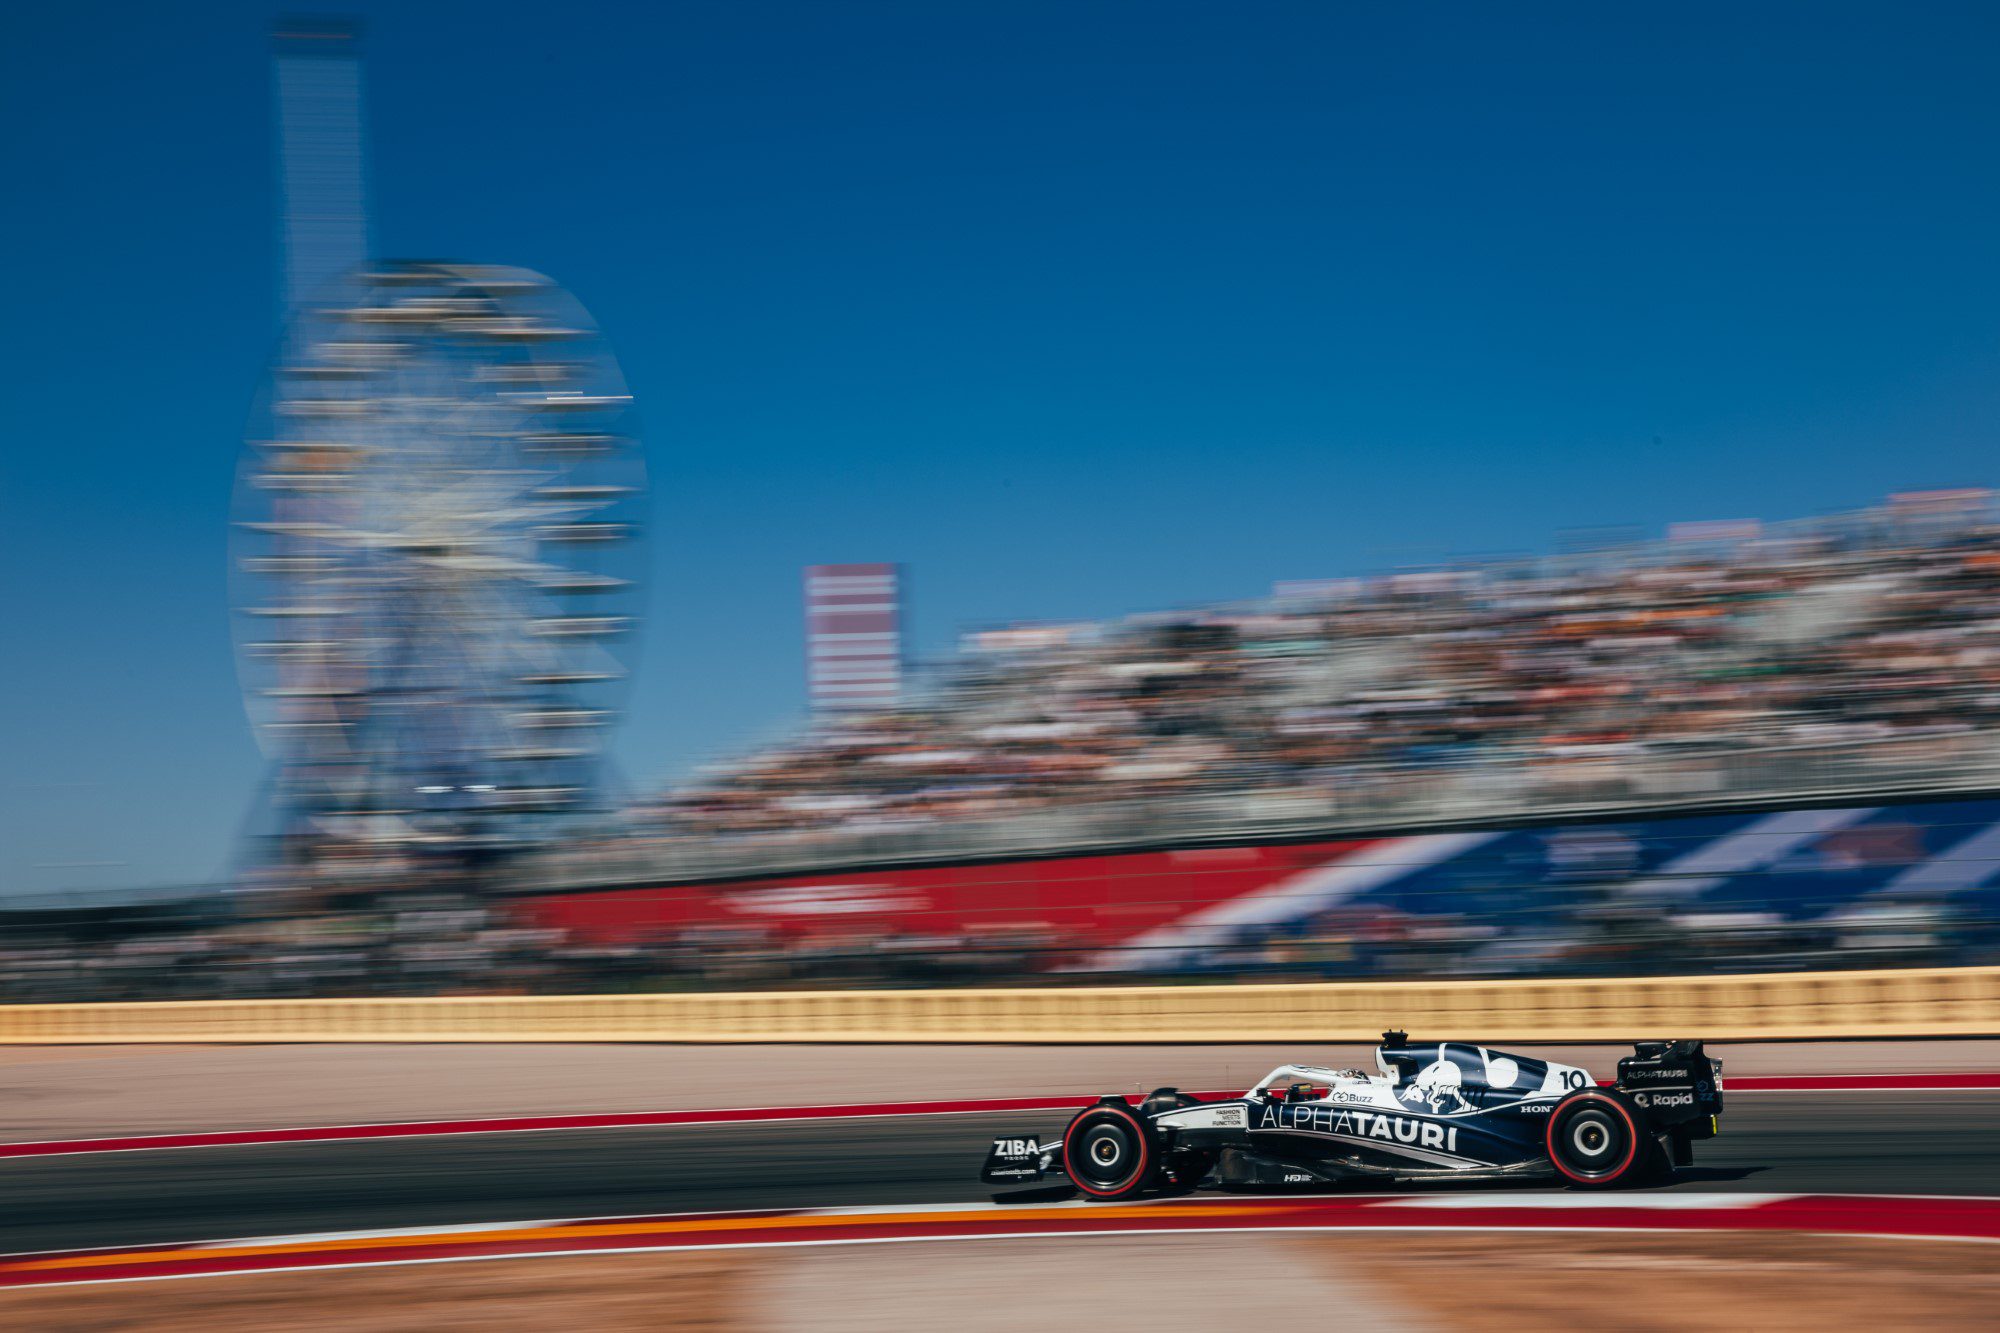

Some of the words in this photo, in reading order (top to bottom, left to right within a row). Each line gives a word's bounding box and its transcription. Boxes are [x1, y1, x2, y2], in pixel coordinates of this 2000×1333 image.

[1559, 1070, 1586, 1090] 10
[1350, 1094, 1373, 1102] Buzz
[1652, 1092, 1694, 1107] Rapid
[1260, 1104, 1457, 1151] ALPHATAURI
[994, 1140, 1040, 1156] ZIBA
